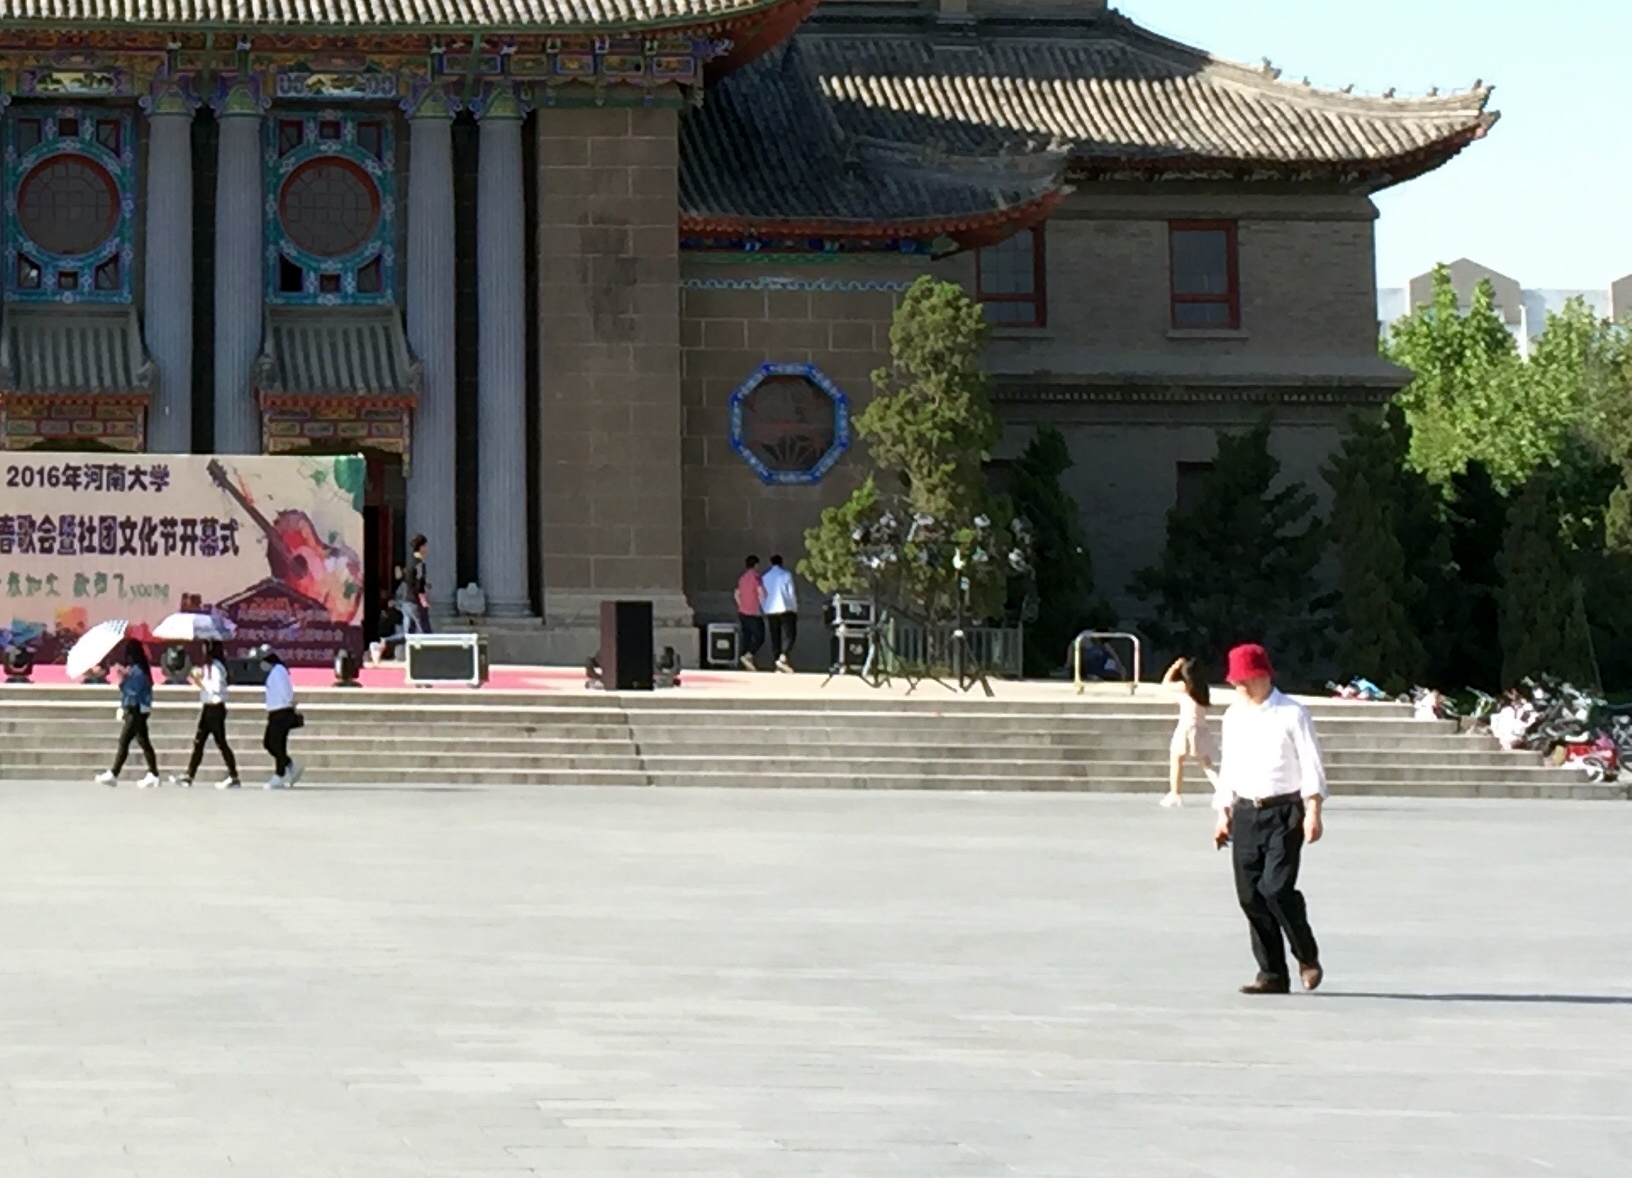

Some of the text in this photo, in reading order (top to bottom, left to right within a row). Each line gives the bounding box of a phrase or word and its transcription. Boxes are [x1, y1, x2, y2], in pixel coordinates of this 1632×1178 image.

[6, 463, 170, 492] 2016年河南大学
